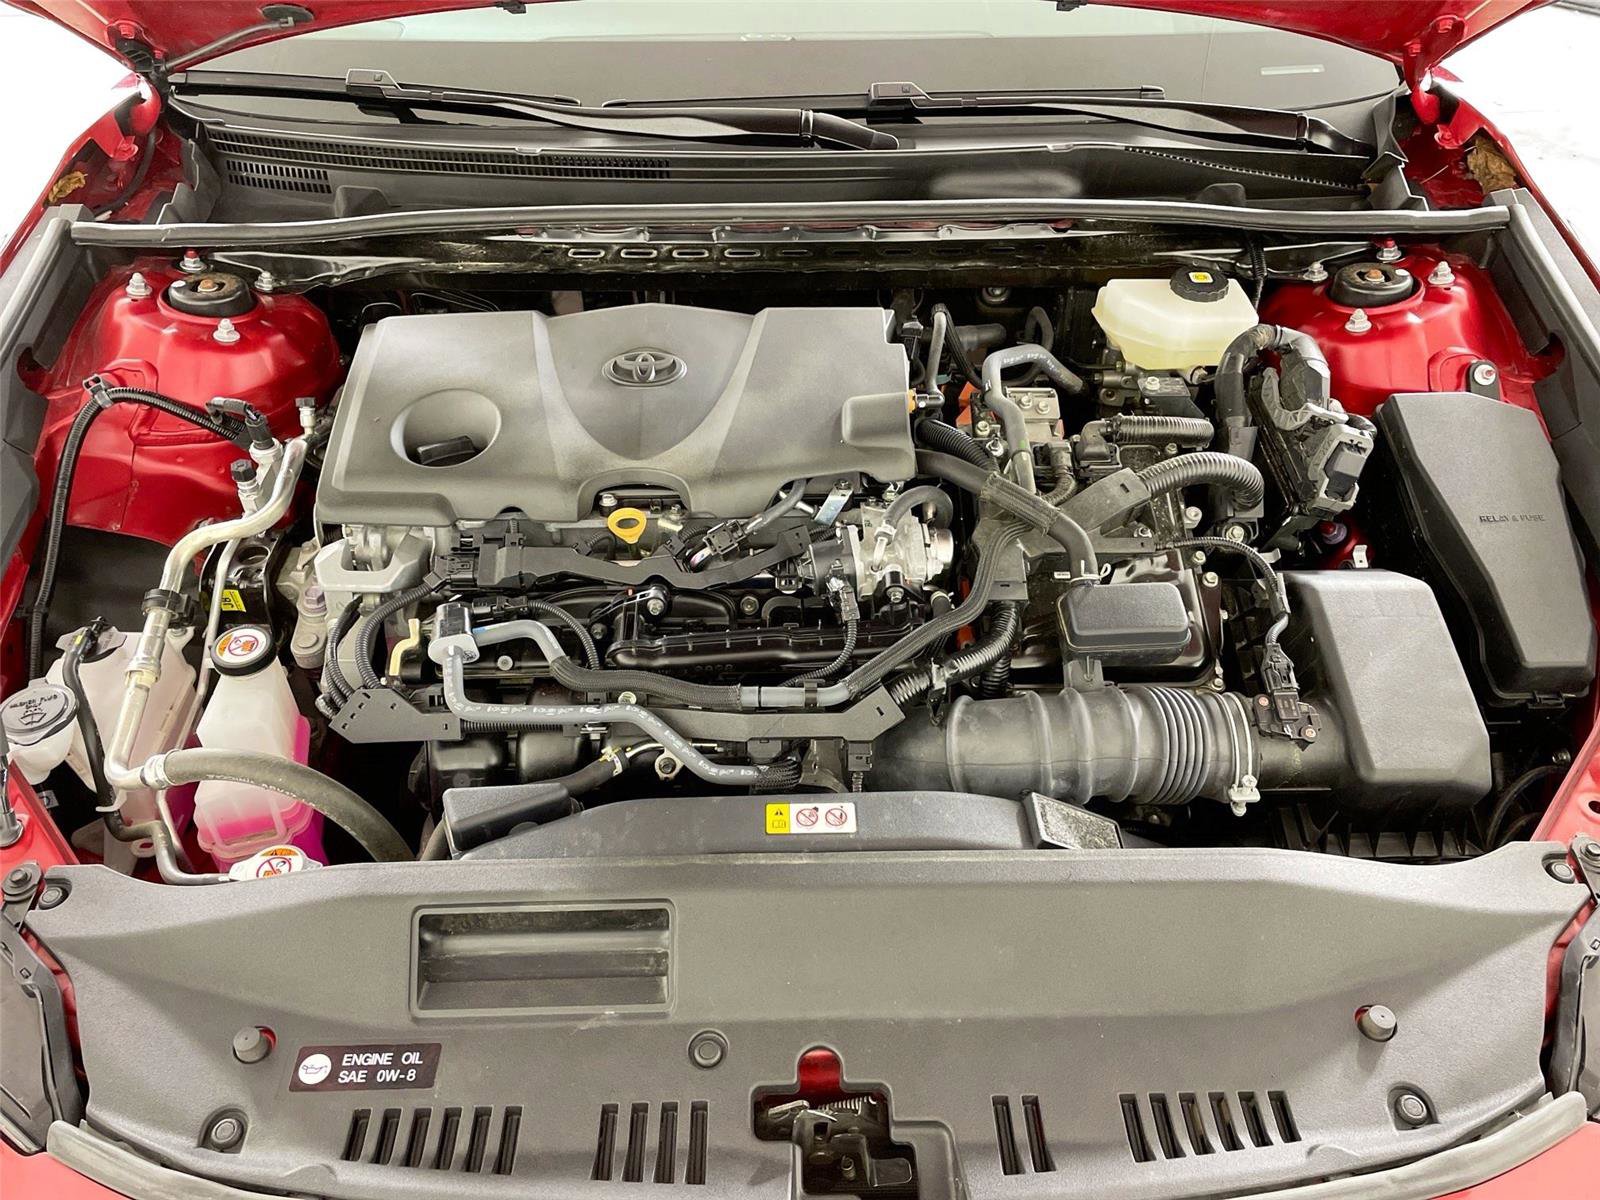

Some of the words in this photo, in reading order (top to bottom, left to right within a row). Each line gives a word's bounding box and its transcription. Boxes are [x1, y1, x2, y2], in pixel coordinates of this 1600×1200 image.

[1479, 514, 1510, 523] RELAY
[1520, 513, 1546, 522] FUSE
[341, 1052, 394, 1066] ENGINE
[401, 1051, 424, 1065] OIL
[337, 1070, 368, 1084] SAE
[376, 1069, 416, 1083] 0W-8
